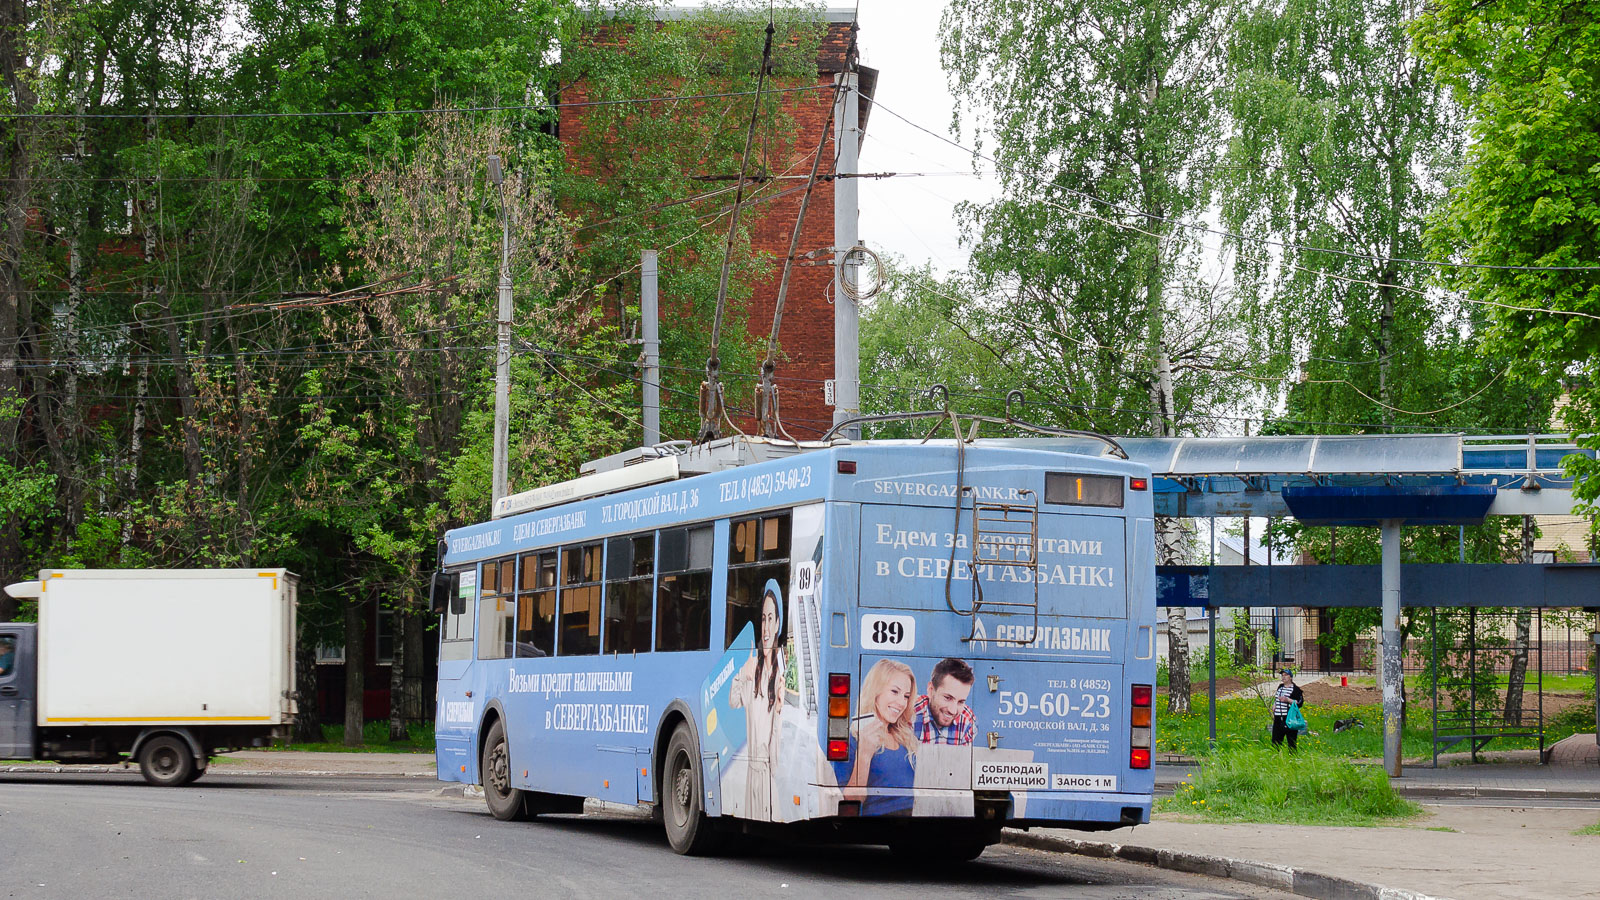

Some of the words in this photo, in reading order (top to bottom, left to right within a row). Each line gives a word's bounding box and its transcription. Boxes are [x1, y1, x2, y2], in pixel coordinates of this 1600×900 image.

[719, 480, 740, 503] ТЕЛ.
[741, 479, 747, 498] 8
[748, 473, 773, 502] (4852)
[774, 465, 812, 492] 59-60-23
[1076, 478, 1082, 500] 1
[601, 505, 612, 524] УЛ.
[613, 491, 660, 523] ГОРОДСКОЙ
[661, 492, 680, 515] ВАЛ,
[680, 490, 688, 515] Д.
[690, 488, 700, 508] 36
[513, 522, 530, 544] ЕДЕМ
[531, 522, 536, 537] В
[536, 510, 587, 536] СЕВЕРГАЗБАНК!
[875, 523, 937, 549] Едем
[944, 532, 968, 549] за
[451, 529, 502, 554] SEVERGAZBANK.RU
[799, 567, 811, 590] 89
[875, 561, 890, 576] в
[871, 620, 904, 644] 89
[996, 625, 1111, 652] СЕВЕРГАЗБАНК
[508, 667, 540, 693] Возьми
[541, 672, 573, 700] кредит
[573, 671, 633, 692] наличными
[1047, 679, 1068, 689] ТЕЛ.
[1070, 679, 1077, 689] 8
[1079, 679, 1111, 692] (4852)
[998, 691, 1111, 718] 59-60-23
[545, 710, 552, 730] в
[553, 703, 649, 734] СЕВЕРГАЗБАНКЕ!
[992, 720, 1007, 729] УЛ.
[1008, 719, 1065, 731] ГОРОДСКОЙ
[1067, 722, 1088, 732] ВАЛ,
[1089, 723, 1098, 733] Д.
[1100, 723, 1110, 731] 36
[978, 775, 1046, 786] ДИСТАНЦИЮ
[981, 765, 1042, 775] СОБЛЮДАЙ
[1057, 778, 1091, 787] ЗАНОС
[1094, 779, 1100, 787] 1
[1103, 779, 1112, 787] М
